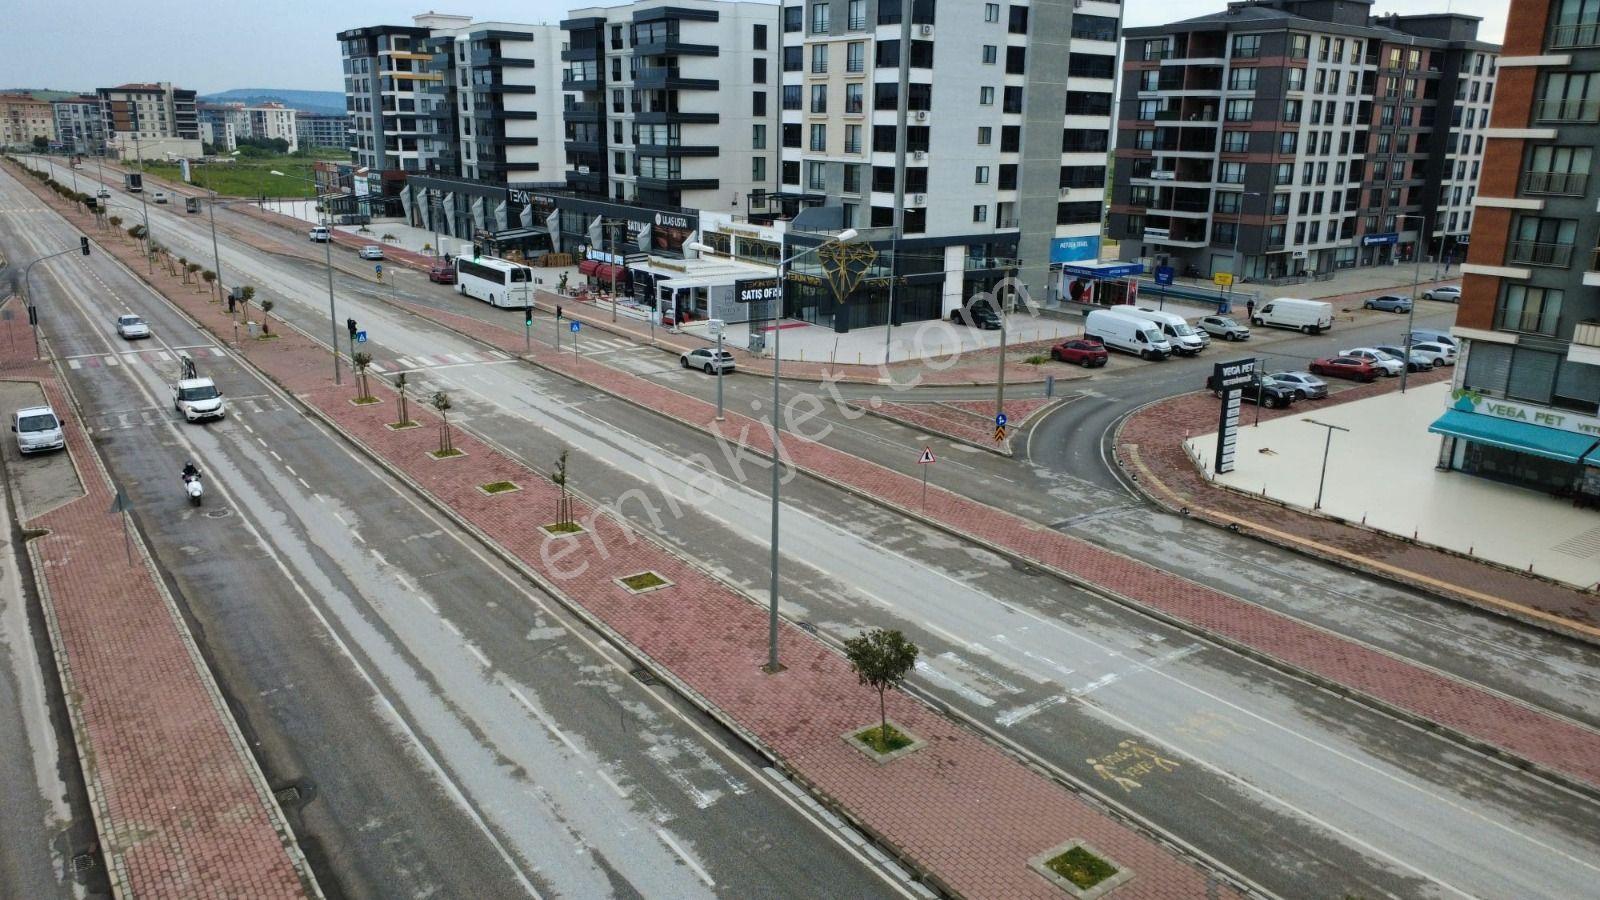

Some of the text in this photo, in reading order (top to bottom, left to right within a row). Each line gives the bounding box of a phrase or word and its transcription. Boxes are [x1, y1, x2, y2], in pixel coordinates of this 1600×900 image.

[741, 288, 763, 301] SATIŞ
[1222, 362, 1255, 377] VEGA PET
[1486, 402, 1526, 420] VEGA
[1533, 411, 1565, 426] PET
